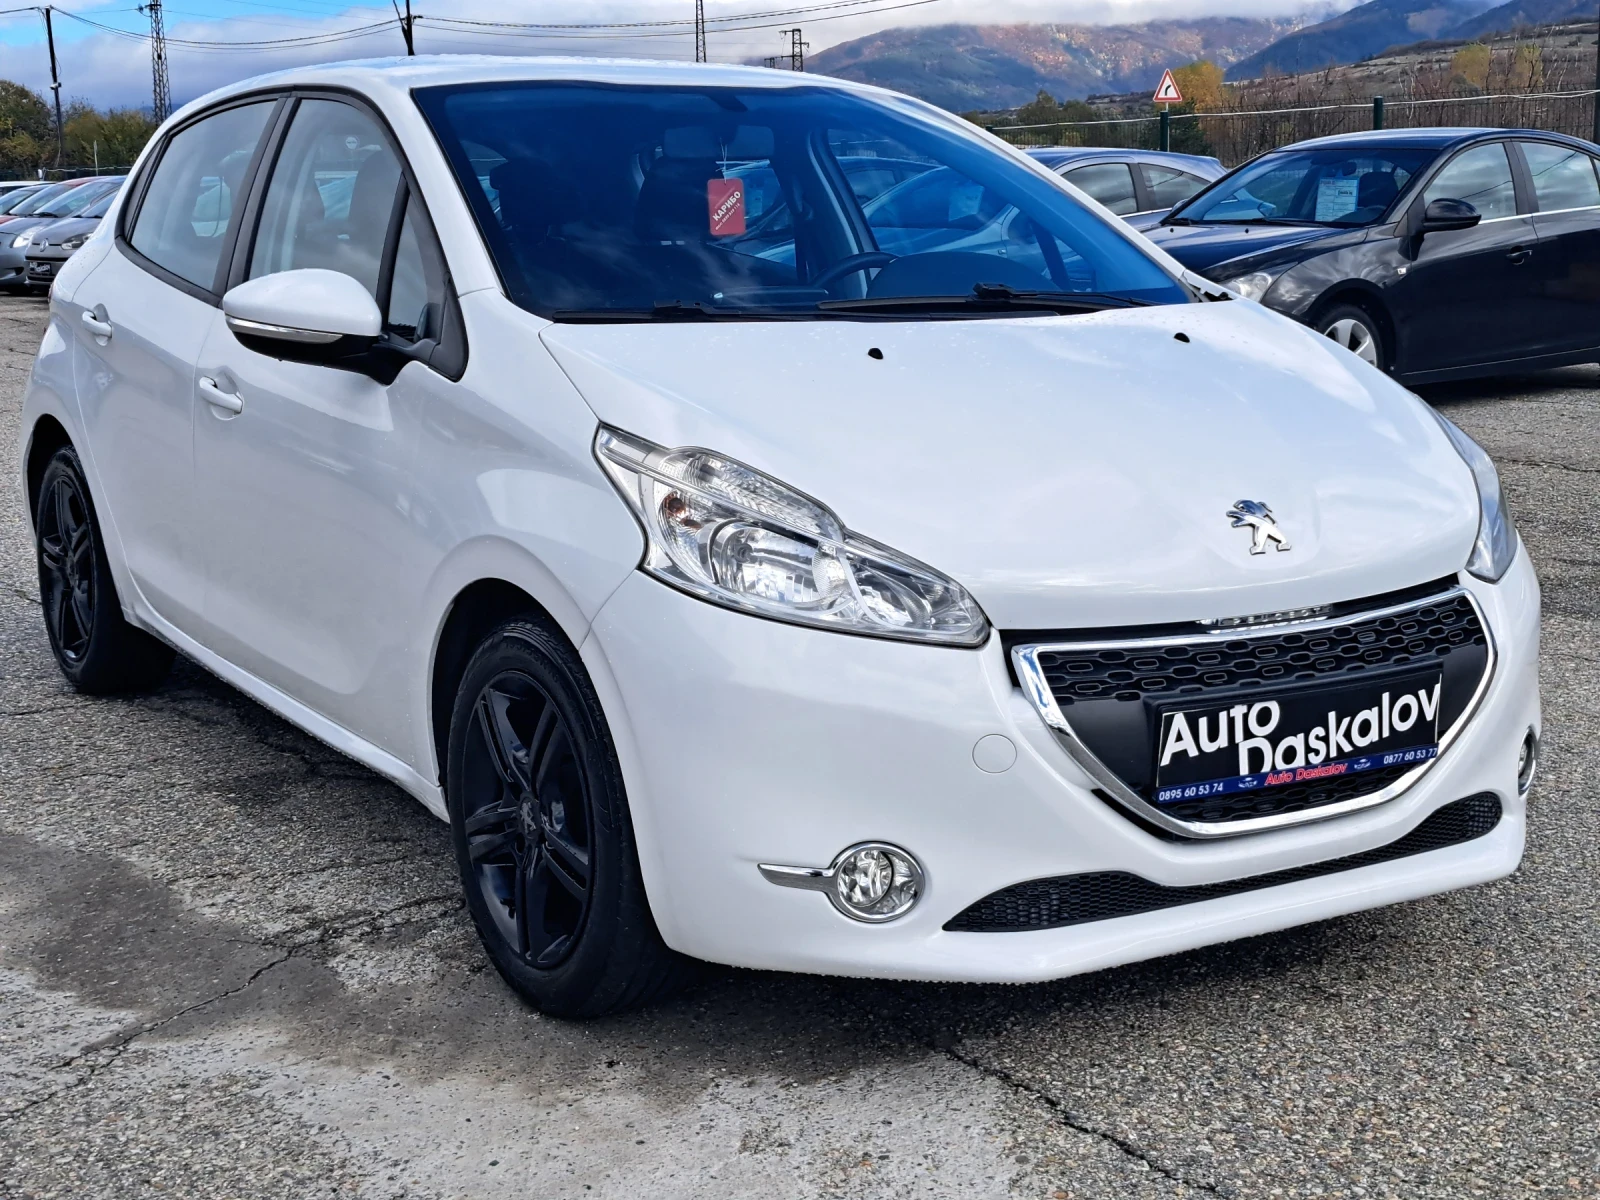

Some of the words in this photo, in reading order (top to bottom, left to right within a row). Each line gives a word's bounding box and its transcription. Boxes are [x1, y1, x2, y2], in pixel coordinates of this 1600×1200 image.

[712, 191, 741, 221] КАРИБО
[1239, 683, 1441, 776] Daskalov
[1158, 788, 1182, 801] 0895
[1184, 786, 1197, 797] 60
[1198, 784, 1210, 795] 53
[1212, 782, 1224, 793] 74
[1264, 771, 1293, 786] Auto
[1296, 763, 1348, 780] Daskalov
[1383, 753, 1403, 764] 0877
[1404, 751, 1415, 761] 60
[1416, 749, 1426, 759] 53
[1428, 747, 1438, 758] 77
